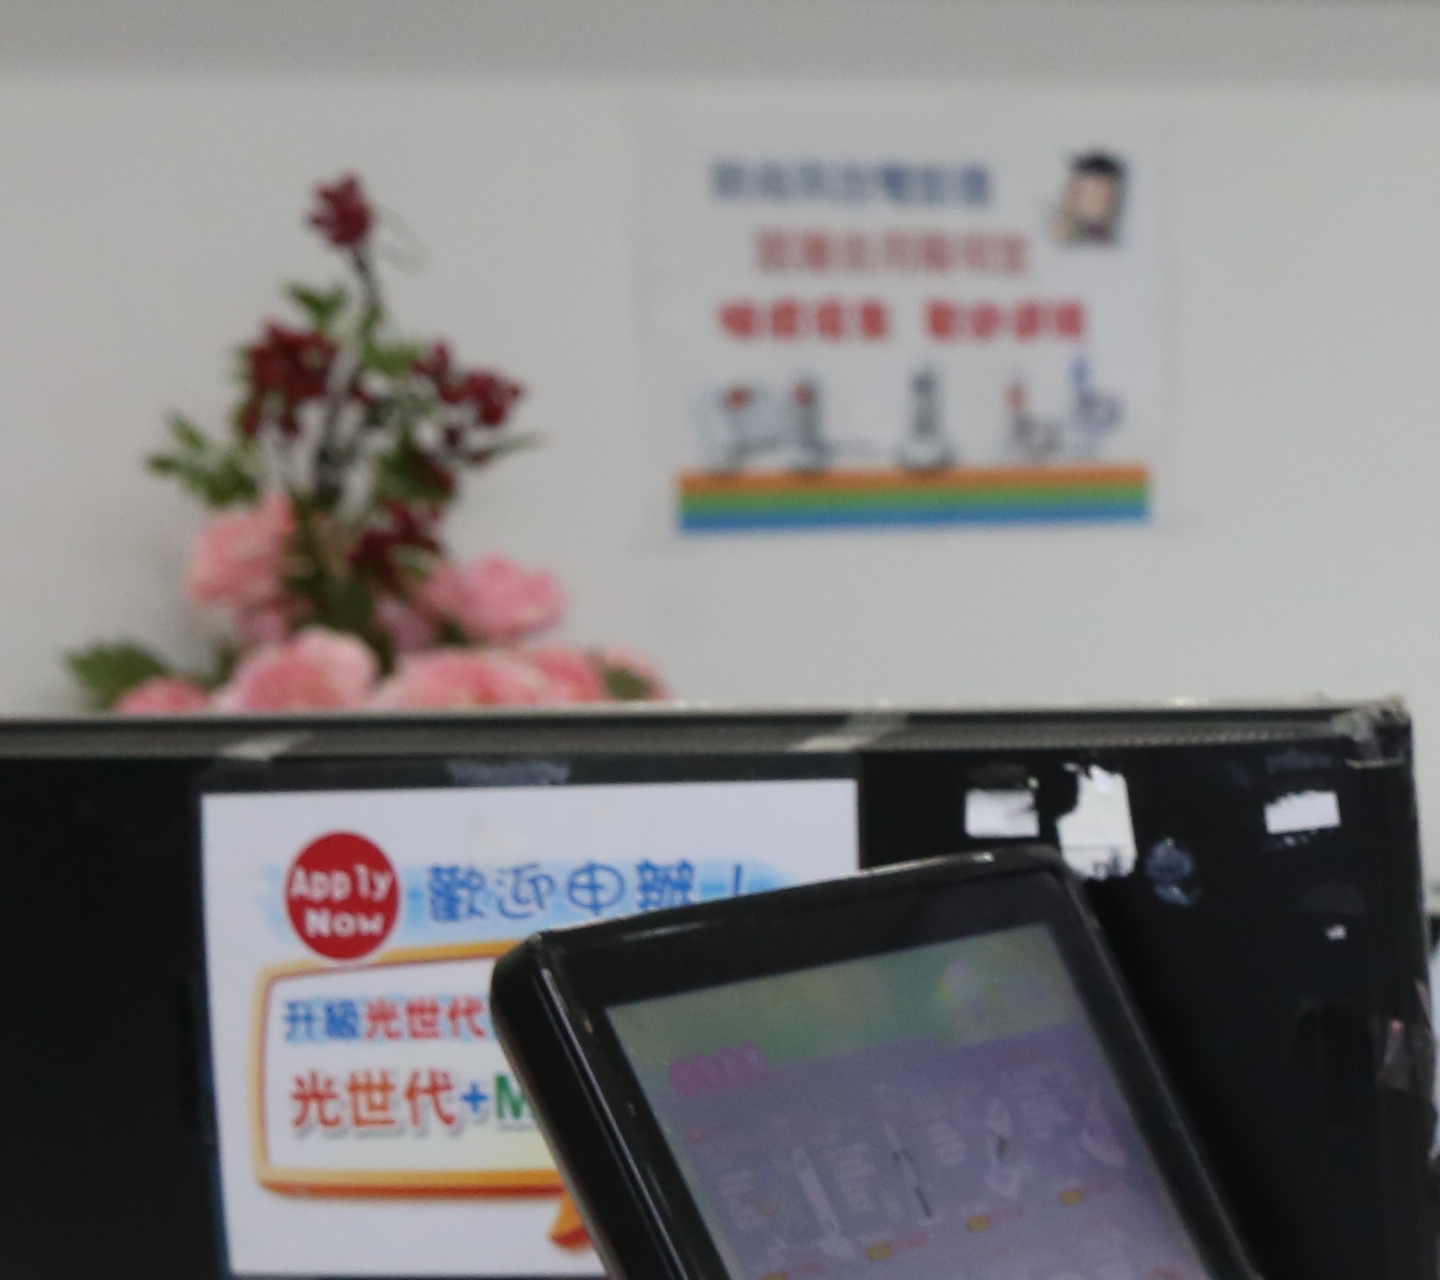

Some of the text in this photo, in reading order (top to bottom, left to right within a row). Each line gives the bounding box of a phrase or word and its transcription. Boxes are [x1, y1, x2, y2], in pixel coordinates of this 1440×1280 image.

[291, 861, 394, 903] Apply
[303, 908, 386, 938] Now
[291, 1067, 534, 1130] 光世代+M
